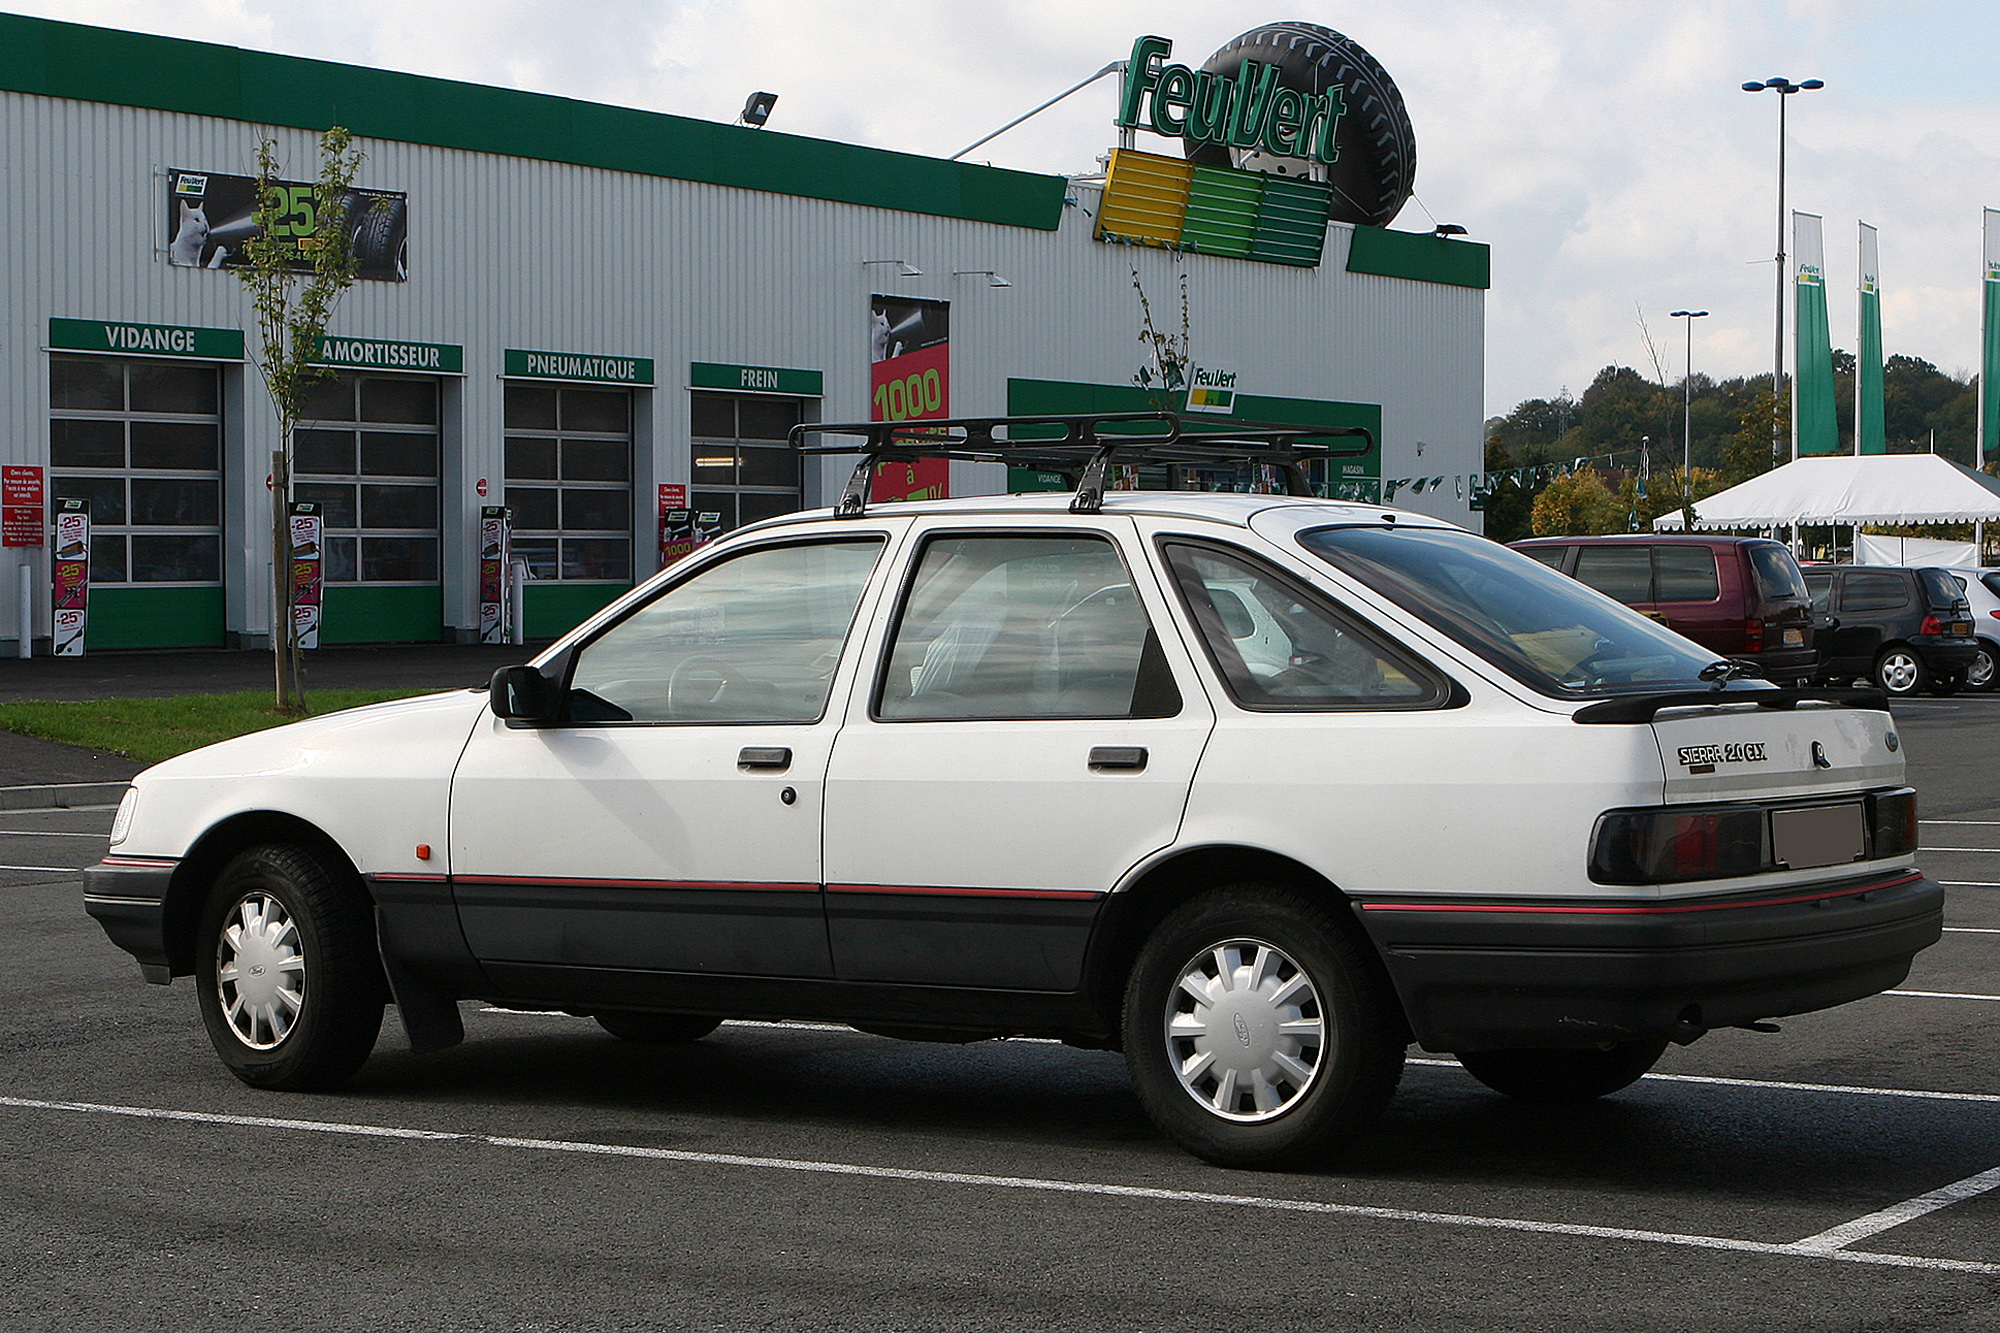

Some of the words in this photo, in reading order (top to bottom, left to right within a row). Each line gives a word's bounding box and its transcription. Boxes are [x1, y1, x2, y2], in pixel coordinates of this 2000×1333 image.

[104, 325, 196, 352] VIDANGE
[322, 339, 440, 368] AMORTISSEUR
[527, 353, 636, 380] PNEUMATIQUE
[741, 368, 778, 389] FREIN
[873, 367, 941, 422] 1000
[1678, 744, 1724, 766] SIERRA
